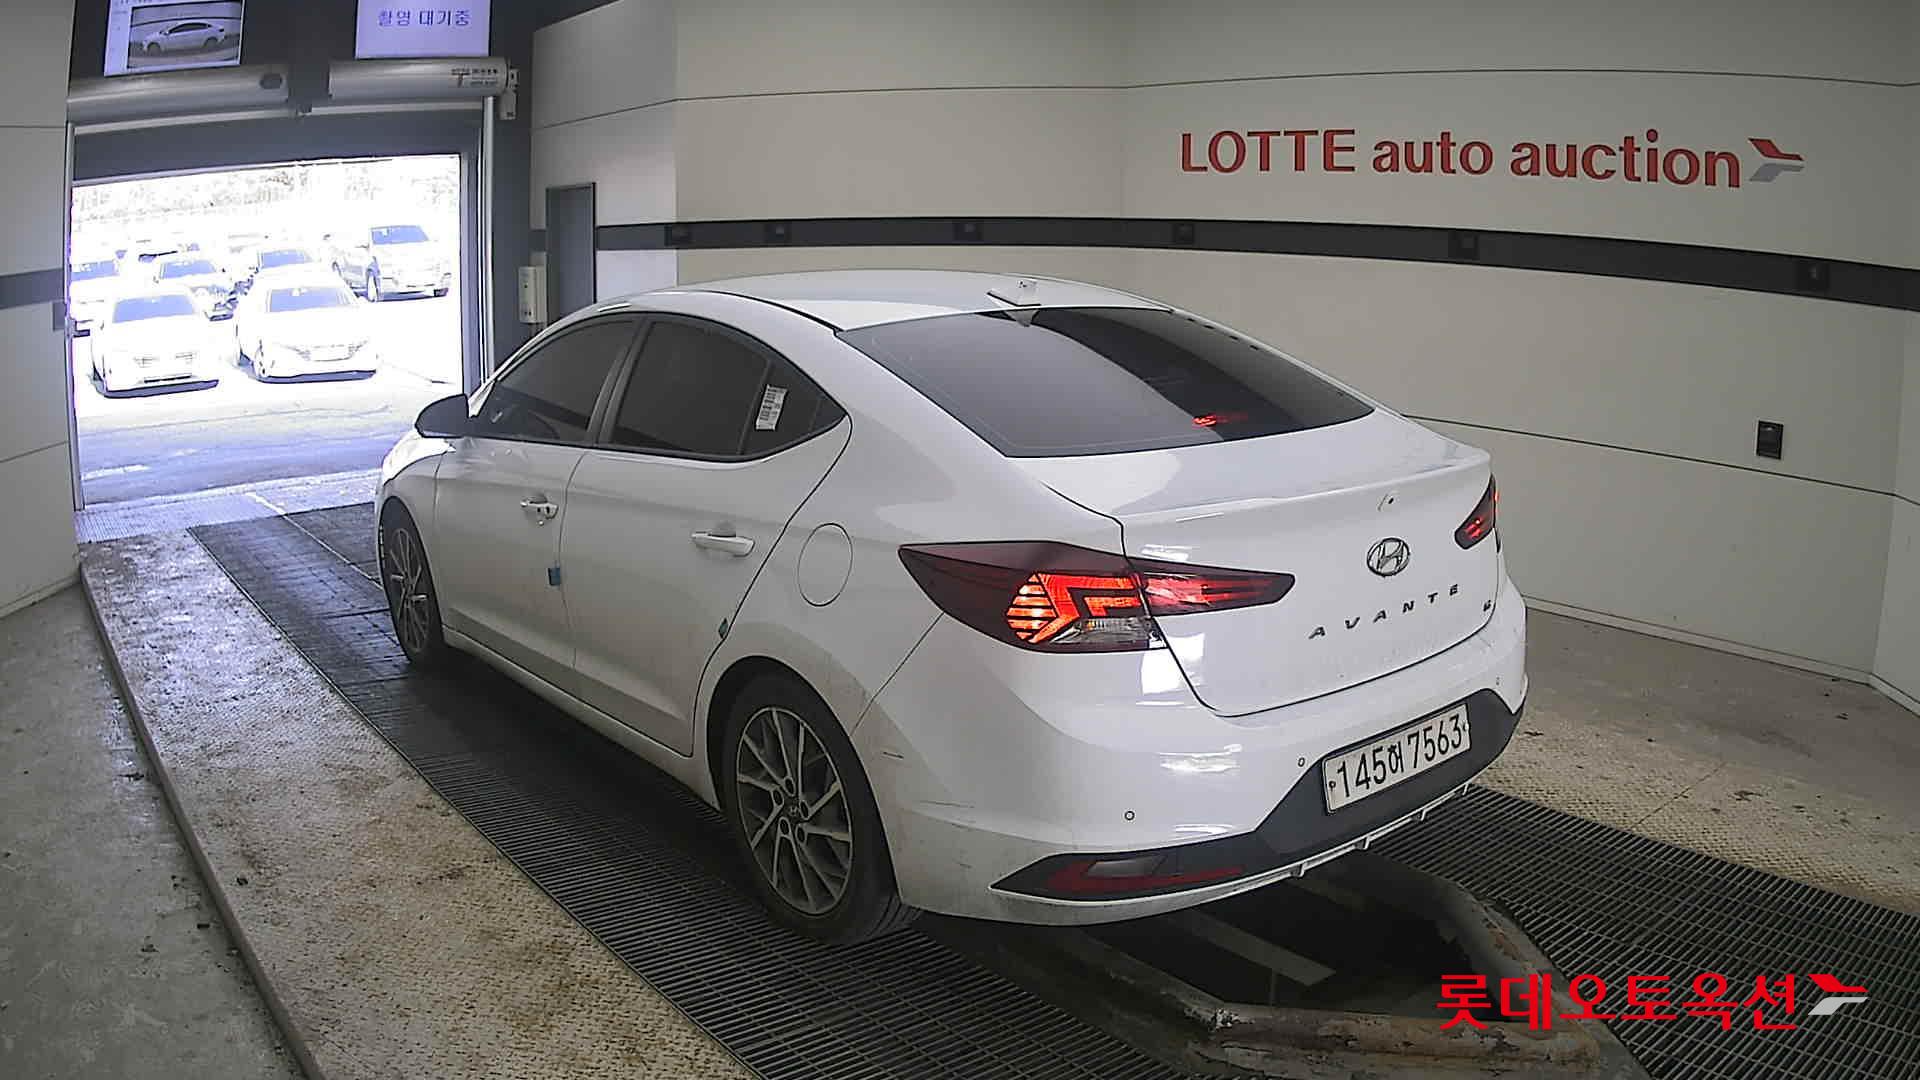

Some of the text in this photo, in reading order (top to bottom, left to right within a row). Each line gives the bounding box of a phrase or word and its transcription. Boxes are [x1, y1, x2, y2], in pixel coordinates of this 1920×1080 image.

[419, 10, 469, 26] 대기중
[1181, 129, 1741, 188] LOTTE auto auction
[1308, 583, 1459, 640] AVANTE
